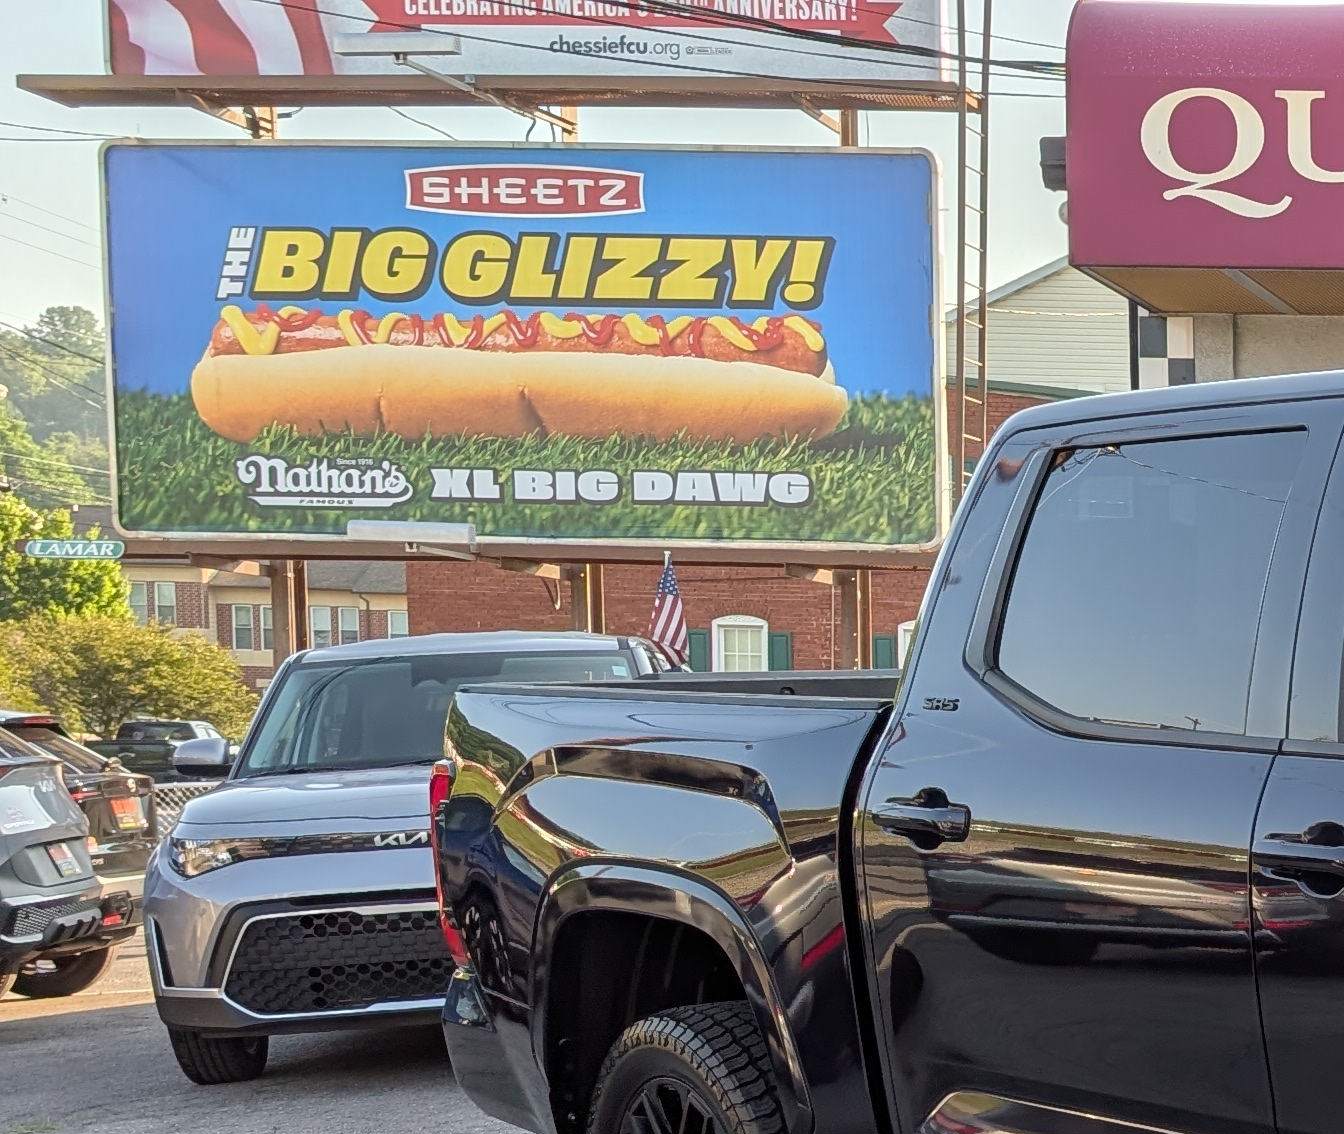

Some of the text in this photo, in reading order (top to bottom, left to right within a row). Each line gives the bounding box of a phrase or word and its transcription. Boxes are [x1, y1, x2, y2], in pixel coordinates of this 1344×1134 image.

[541, 0, 648, 17] AMERICAS
[550, 34, 680, 60] chessiefcu.org
[421, 177, 628, 207] SHEETZ
[216, 226, 828, 305] THE BIG GLIZZY!
[236, 456, 410, 495] Nathan's
[430, 468, 811, 504] XL BIG DAWG
[34, 543, 115, 556] LAMAR
[373, 831, 429, 847] KIA
